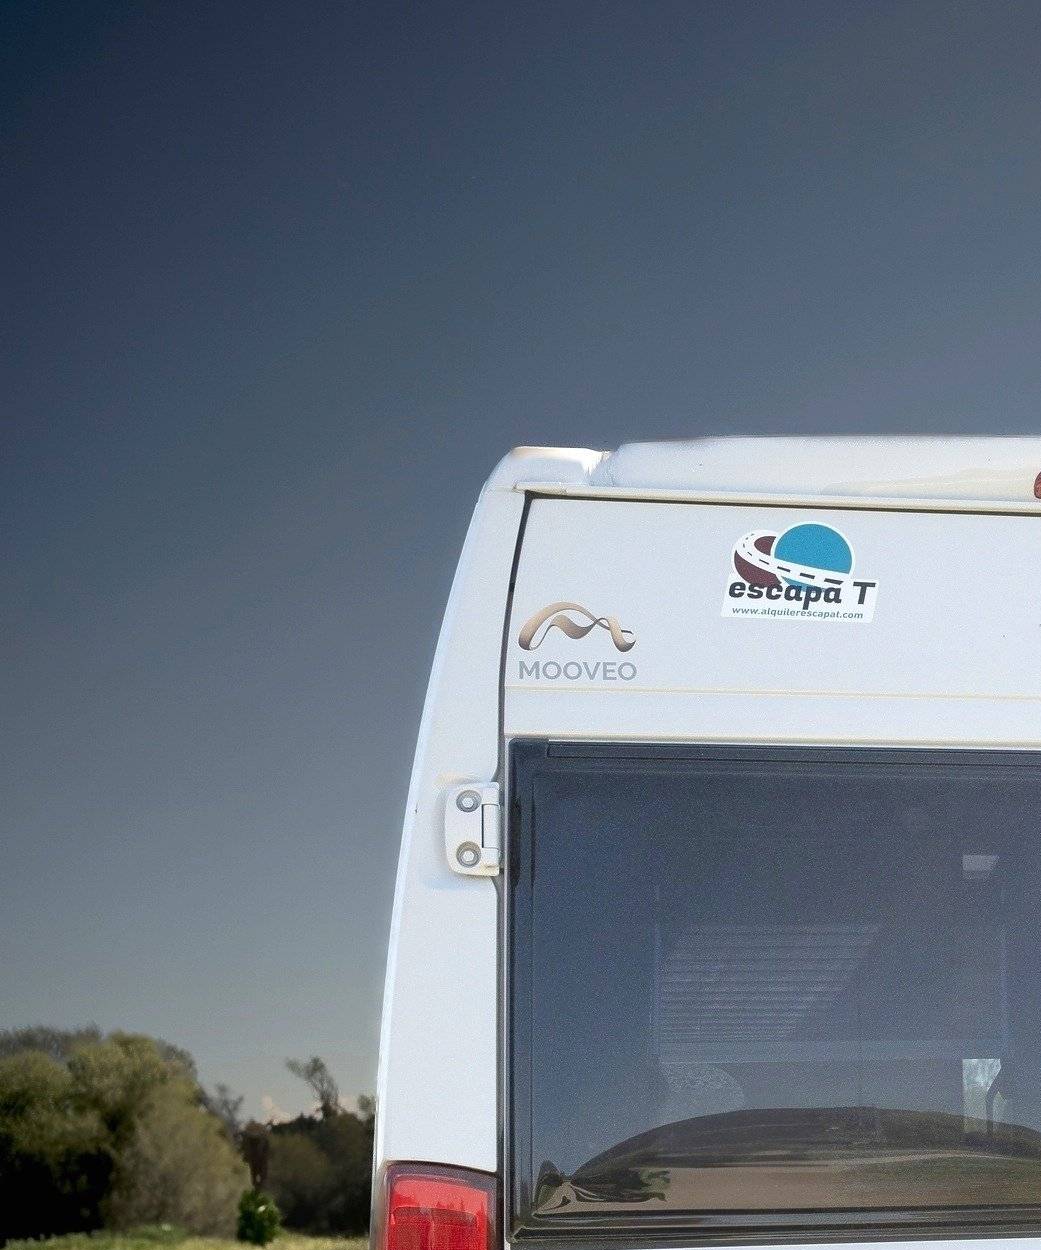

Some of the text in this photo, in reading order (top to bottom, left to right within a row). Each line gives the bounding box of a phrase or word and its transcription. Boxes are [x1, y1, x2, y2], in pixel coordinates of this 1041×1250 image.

[728, 580, 876, 610] escapa T
[732, 607, 863, 620] www.alquilerescapat.com
[518, 660, 637, 681] MOOVEO
